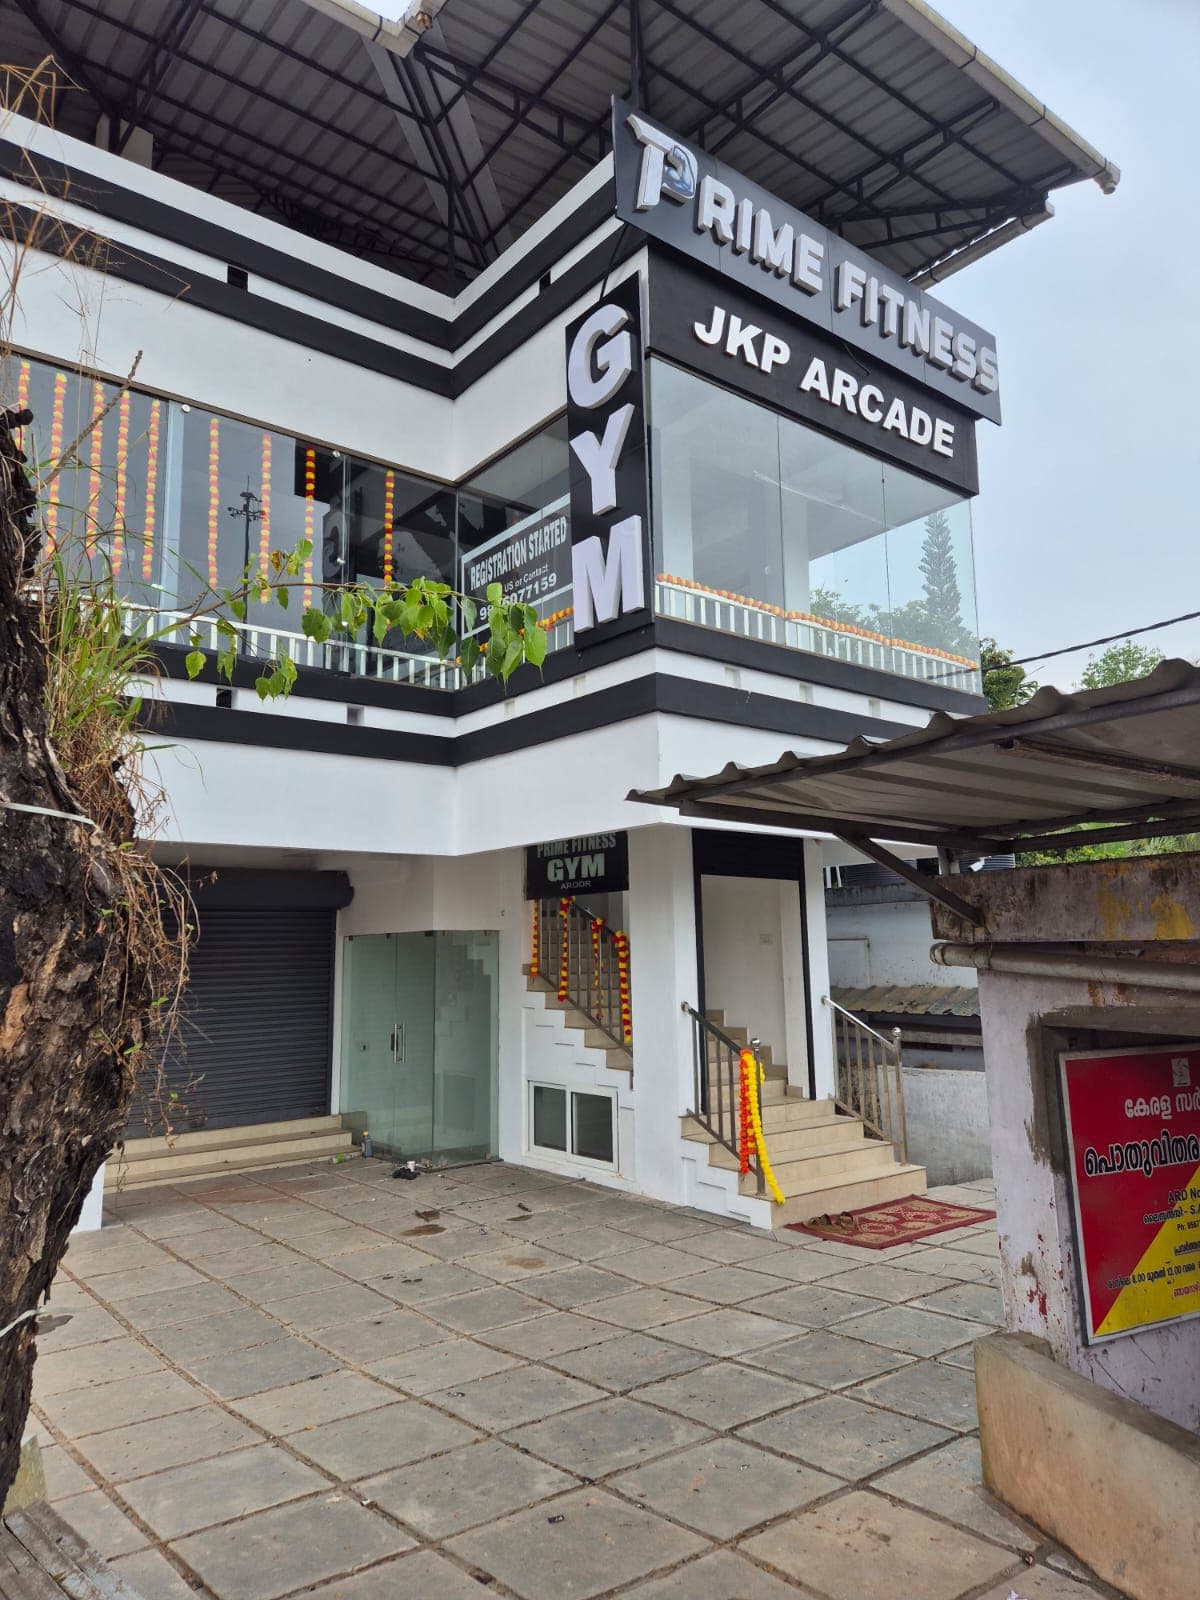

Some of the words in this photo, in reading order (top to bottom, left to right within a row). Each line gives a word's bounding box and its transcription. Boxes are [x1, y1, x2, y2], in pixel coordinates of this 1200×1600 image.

[626, 113, 825, 294] PRIME
[838, 261, 998, 395] FITNESS
[694, 306, 791, 374] JKP
[799, 357, 956, 458] ARCADE
[568, 303, 645, 634] GYM
[470, 538, 527, 591] REGISTRATION
[528, 516, 567, 561] STARTED
[523, 563, 549, 583] Contact
[537, 839, 569, 858] PRIME
[571, 831, 617, 853] FITNESS
[547, 853, 605, 882] GYM
[560, 880, 592, 890] AROOR
[1125, 1094, 1173, 1120] കേരള
